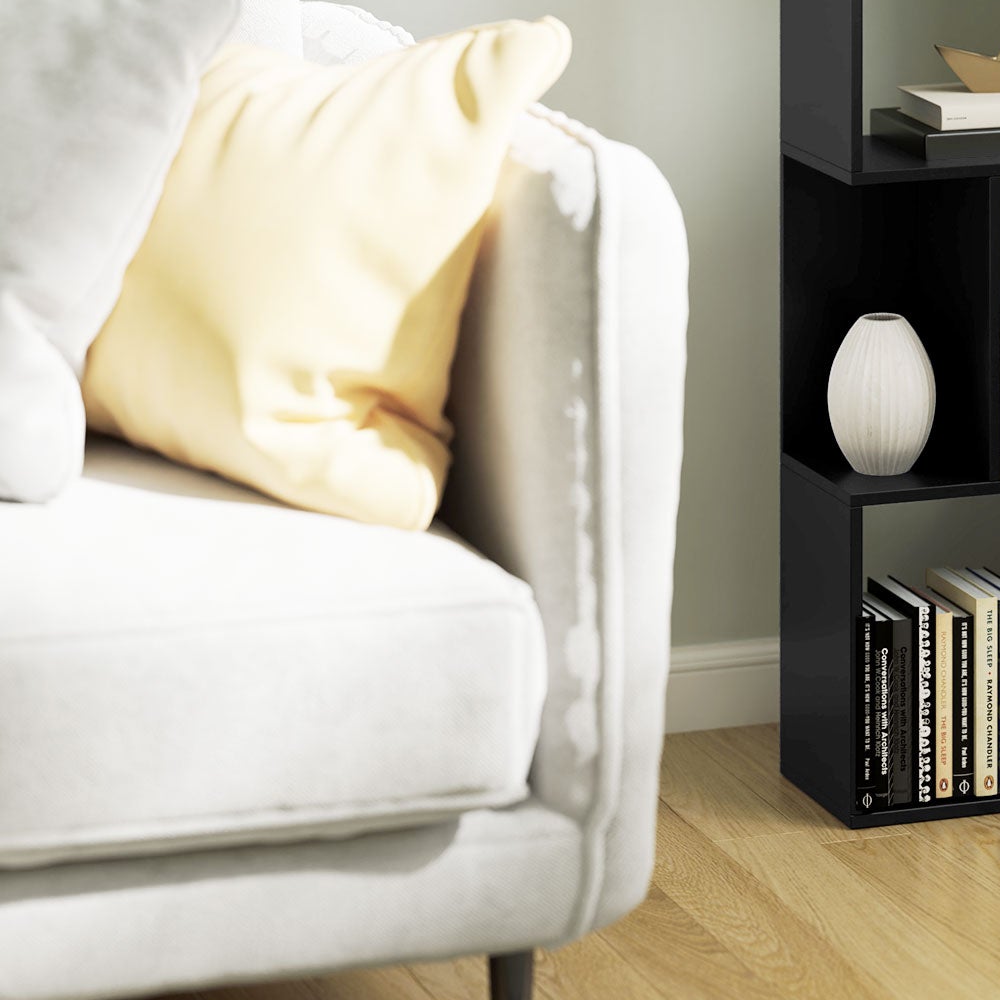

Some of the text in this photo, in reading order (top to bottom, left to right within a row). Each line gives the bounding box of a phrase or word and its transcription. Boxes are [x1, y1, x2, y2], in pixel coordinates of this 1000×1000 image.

[880, 647, 889, 775] Conversations with Architects
[899, 647, 907, 772] Conversations with Architects
